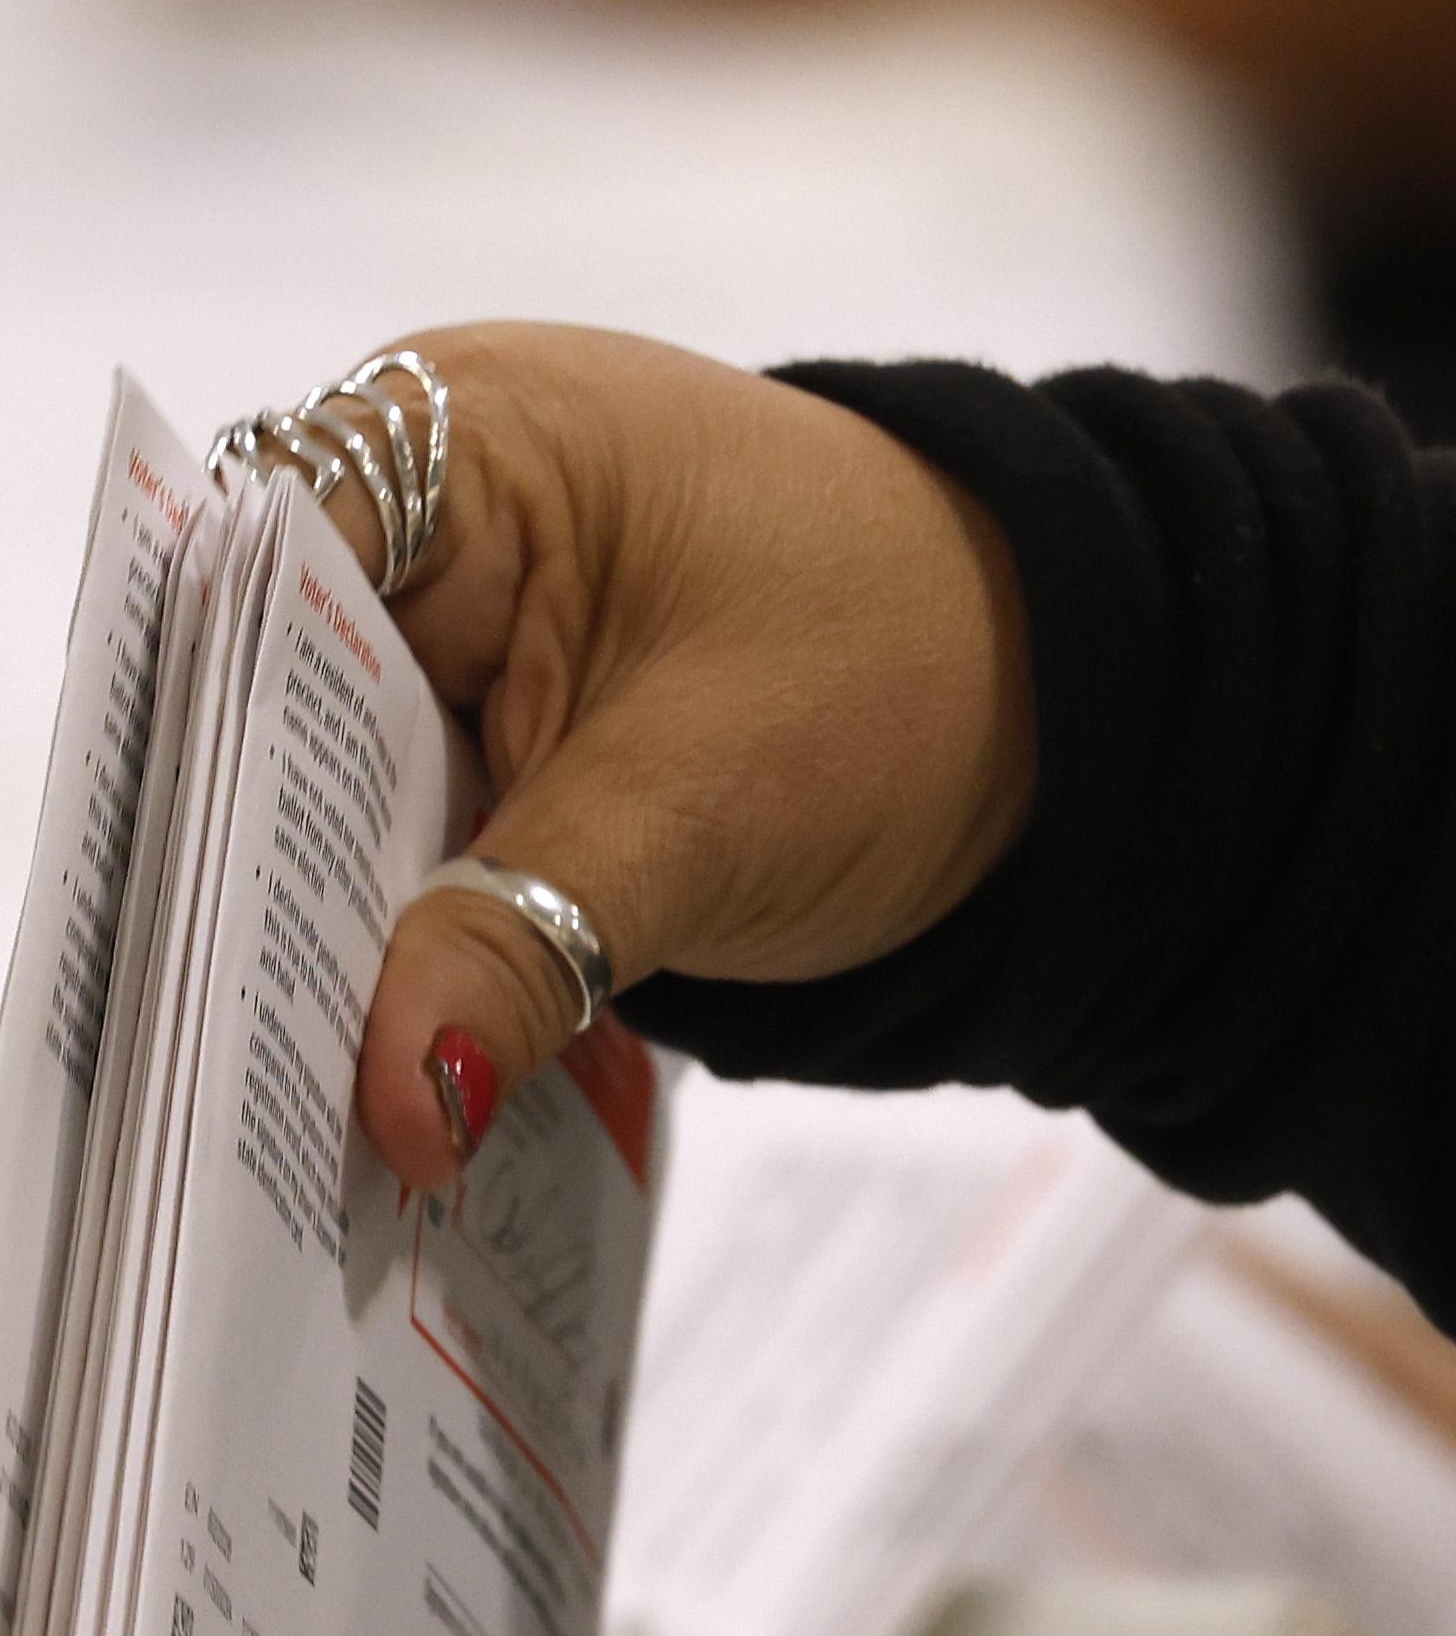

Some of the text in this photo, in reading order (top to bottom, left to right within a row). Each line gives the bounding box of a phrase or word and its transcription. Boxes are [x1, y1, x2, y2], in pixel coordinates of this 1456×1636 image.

[300, 561, 333, 625] Voter's
[333, 602, 382, 685] Declaration
[299, 633, 315, 668] am
[320, 658, 354, 711] resident
[352, 694, 365, 717] of
[324, 713, 342, 739] and
[272, 874, 301, 925] declare
[259, 943, 278, 978] and
[258, 1000, 296, 1065] understand
